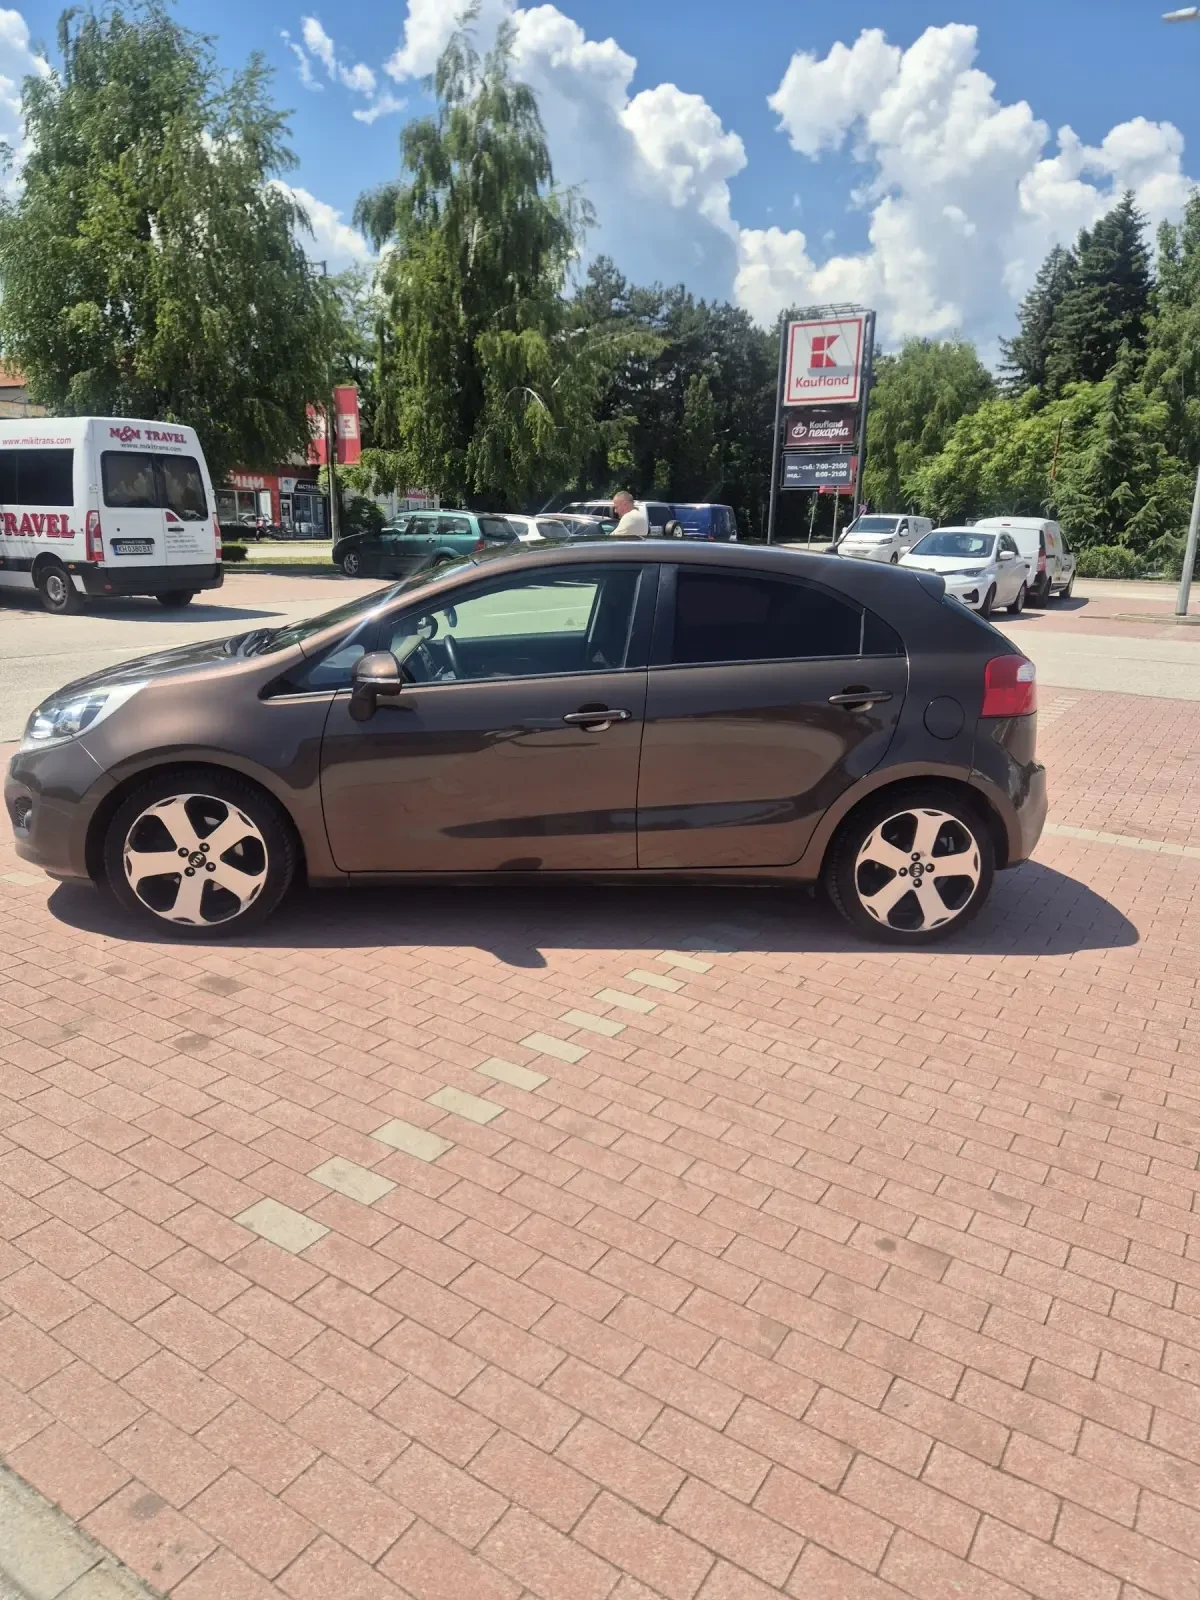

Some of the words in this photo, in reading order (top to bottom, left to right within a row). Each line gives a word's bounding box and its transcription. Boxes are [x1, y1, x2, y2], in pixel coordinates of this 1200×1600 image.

[796, 373, 850, 388] Kaufland
[809, 420, 843, 429] Kaufland
[2, 437, 71, 445] www.mikitrans.com
[109, 426, 141, 442] M&M
[145, 430, 187, 444] TRAVEL
[0, 512, 75, 538] RAVEL
[191, 854, 203, 865] KIA
